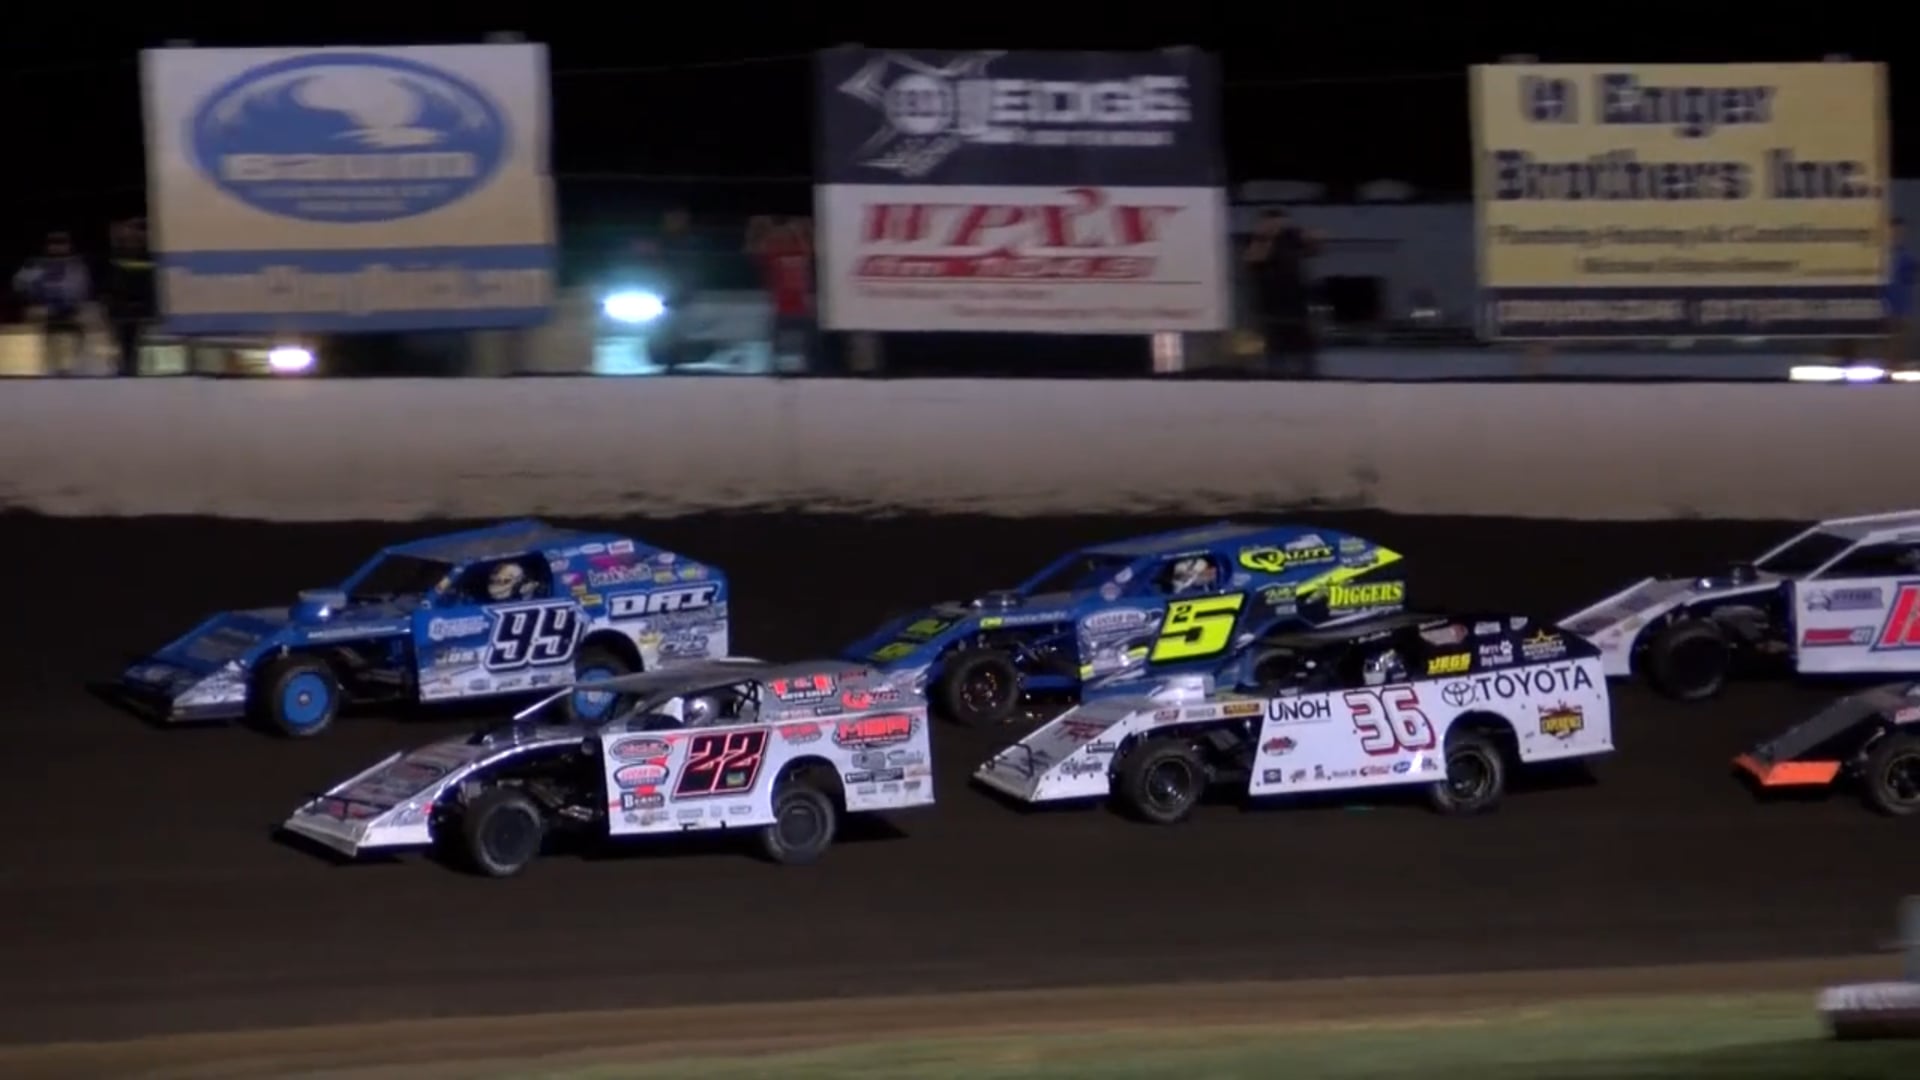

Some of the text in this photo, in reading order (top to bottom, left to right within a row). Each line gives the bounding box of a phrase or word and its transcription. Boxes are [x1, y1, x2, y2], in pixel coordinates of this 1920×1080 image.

[1596, 73, 1774, 137] Enger
[1491, 148, 1881, 199] Brothers Inc.
[609, 586, 716, 617] DAI
[1172, 605, 1192, 623] 2
[1328, 582, 1403, 607] DIGGERS
[487, 605, 577, 667] 99
[1149, 593, 1245, 664] 5
[1427, 653, 1471, 674] JEGS
[1475, 665, 1593, 701] TOYOTA
[1268, 699, 1331, 721] UNOH
[1344, 686, 1436, 755] 36
[675, 729, 768, 797] 22
